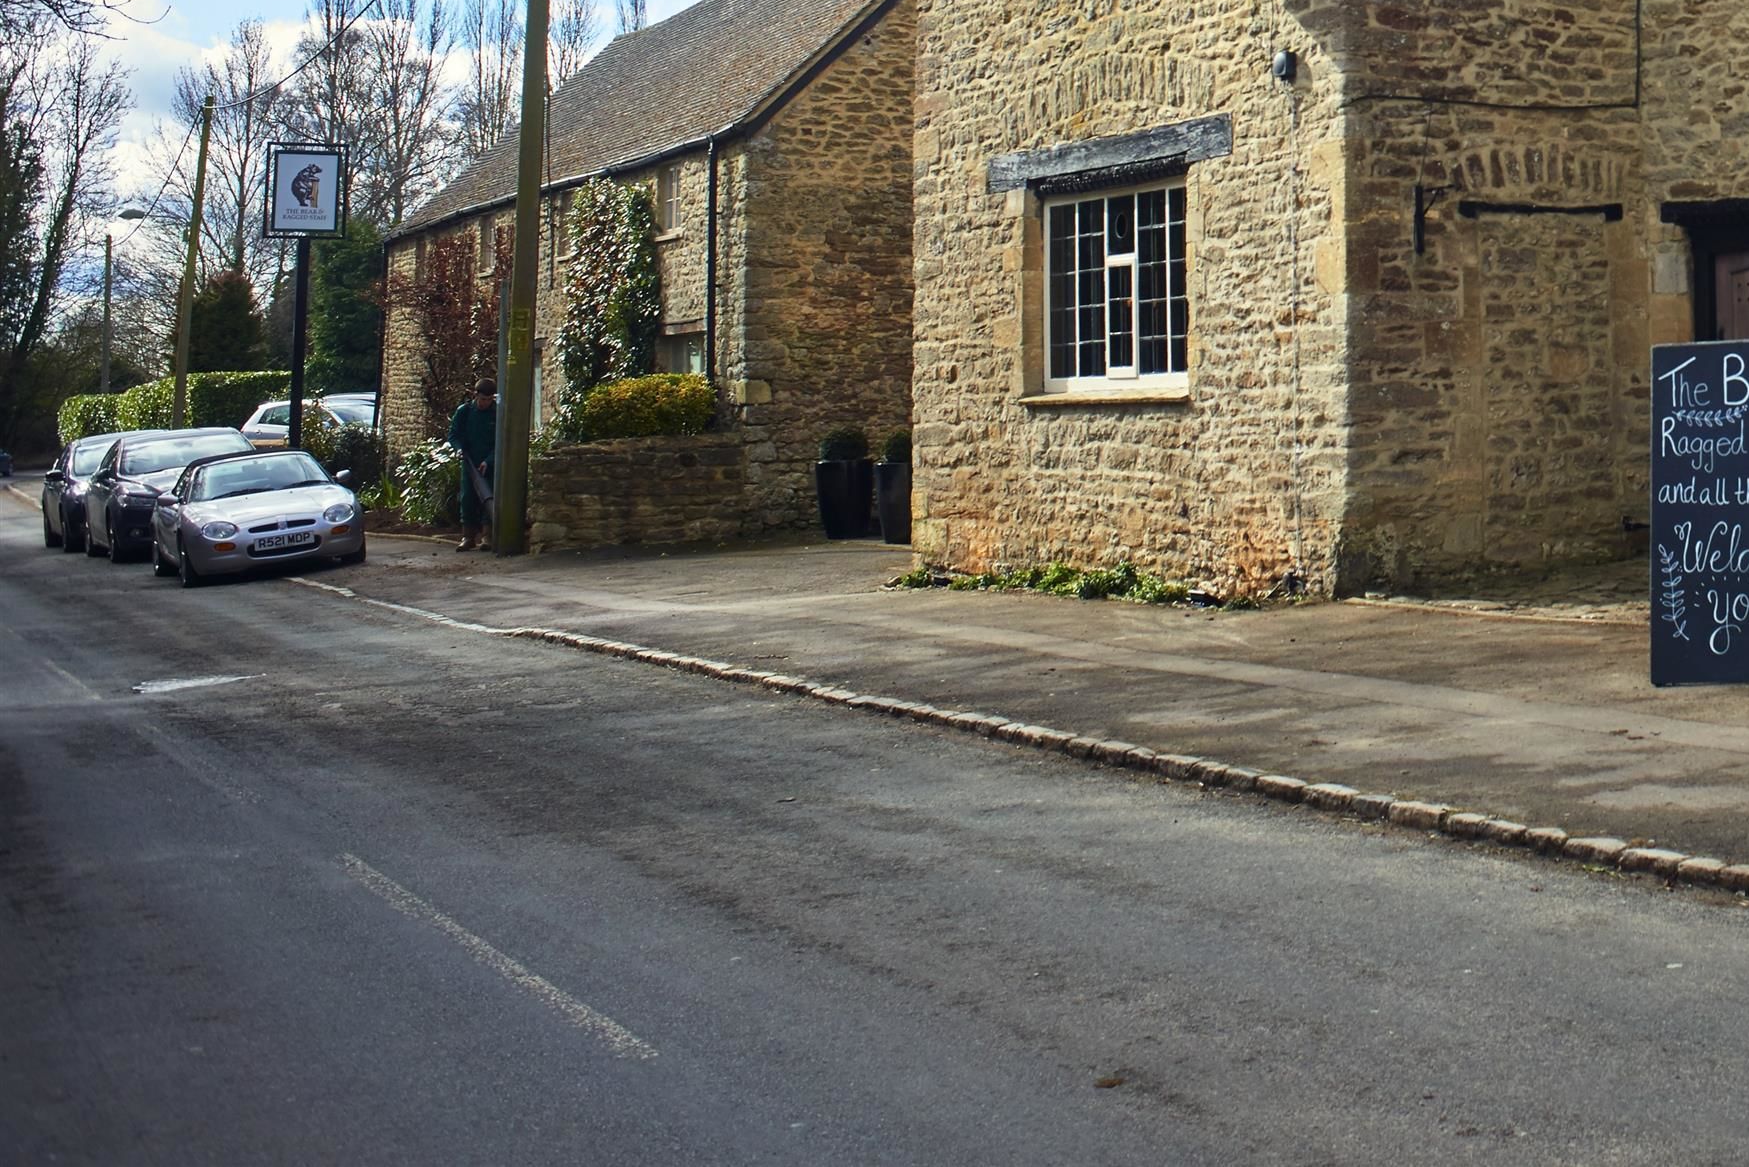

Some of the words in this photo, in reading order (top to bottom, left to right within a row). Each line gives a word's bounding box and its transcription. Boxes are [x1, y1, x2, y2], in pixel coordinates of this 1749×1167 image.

[1658, 356, 1710, 407] The
[1661, 417, 1748, 473] Ragged
[1658, 476, 1697, 504] and
[1699, 477, 1730, 505] all
[258, 536, 285, 548] R521
[287, 532, 311, 545] MDP
